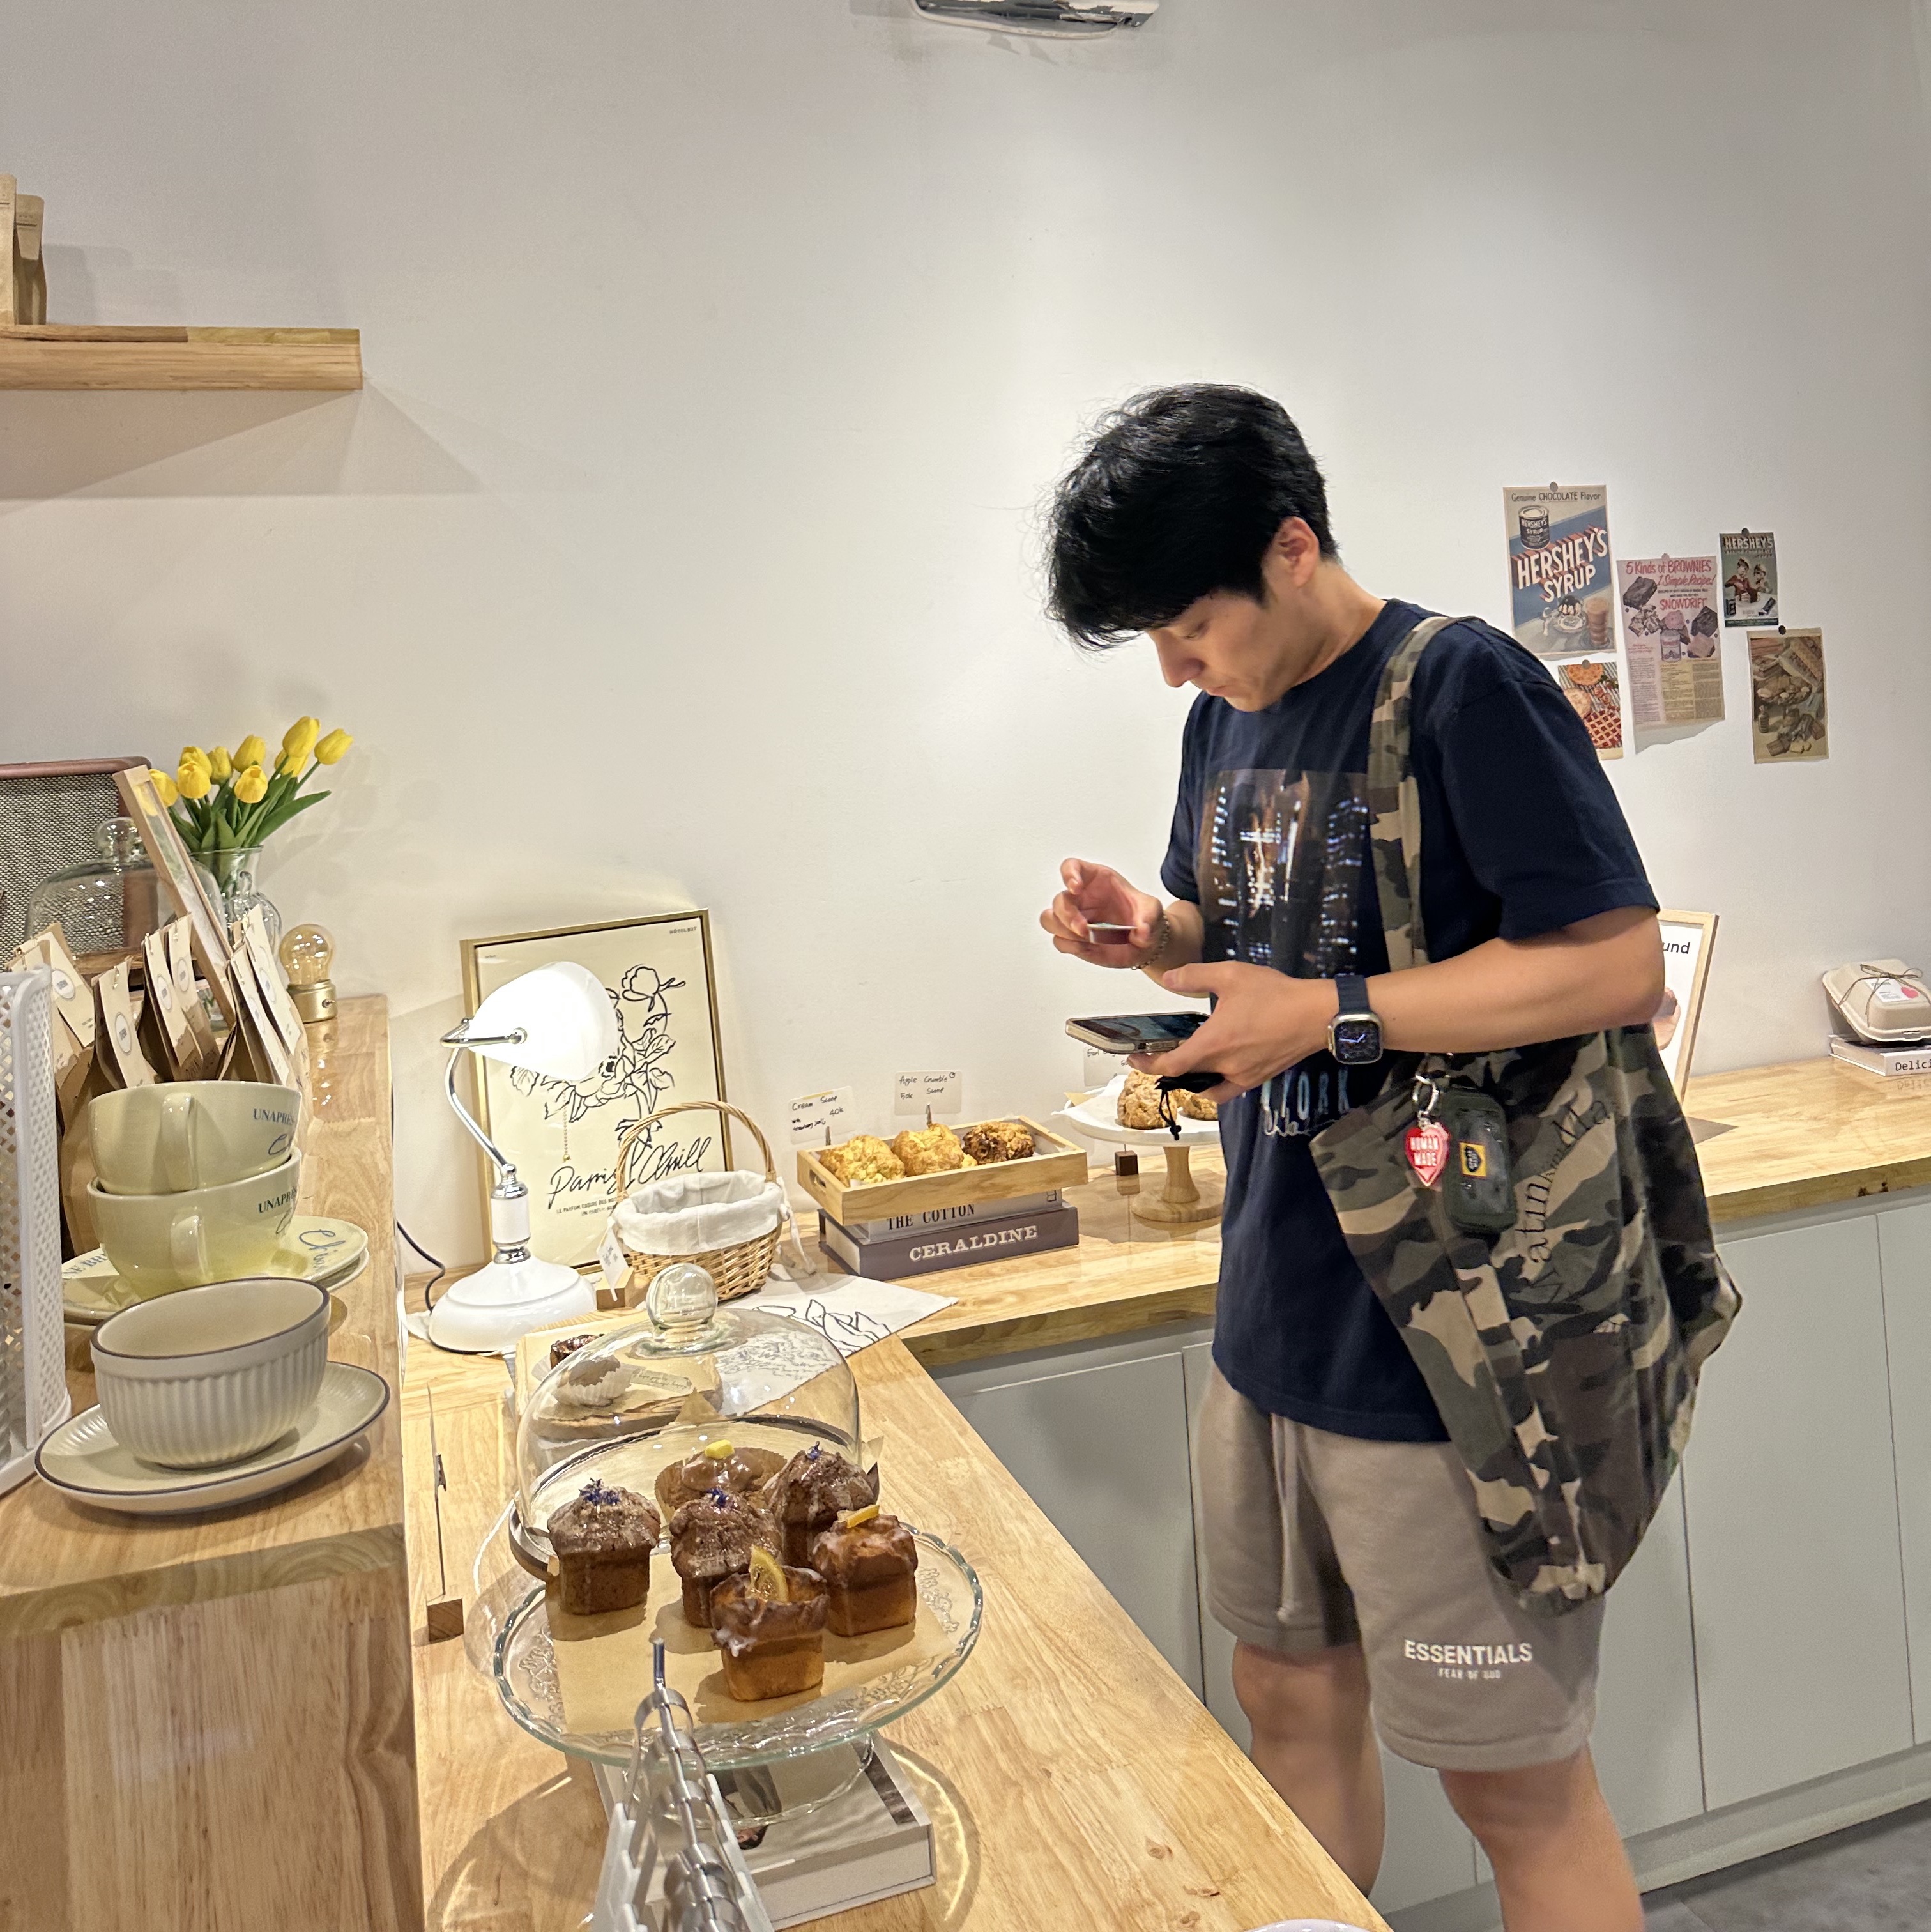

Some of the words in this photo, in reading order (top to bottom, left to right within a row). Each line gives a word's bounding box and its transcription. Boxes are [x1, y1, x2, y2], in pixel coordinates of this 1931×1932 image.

[1511, 493, 1536, 502] Genuine
[1539, 492, 1578, 501] CHOCOLATE
[1580, 492, 1601, 500] Flavor
[1514, 526, 1608, 590] HERSHEY'S
[1626, 562, 1634, 575] 5
[1635, 561, 1656, 574] Kinds
[1658, 562, 1666, 573] of
[1667, 559, 1712, 573] BROWNIES
[1541, 564, 1597, 602] SYRUP
[1660, 597, 1707, 610] SNOWDRIFT
[899, 1075, 917, 1086] Apple
[792, 1103, 813, 1111] Cream
[1414, 1152, 1437, 1166] MADE
[887, 1215, 913, 1230] THE
[922, 1203, 975, 1223] COTTON
[1405, 1639, 1532, 1665] ESSENTIALS
[1438, 1667, 1463, 1680] FEAR
[1468, 1669, 1478, 1680] OF
[1483, 1669, 1501, 1680] GOD
